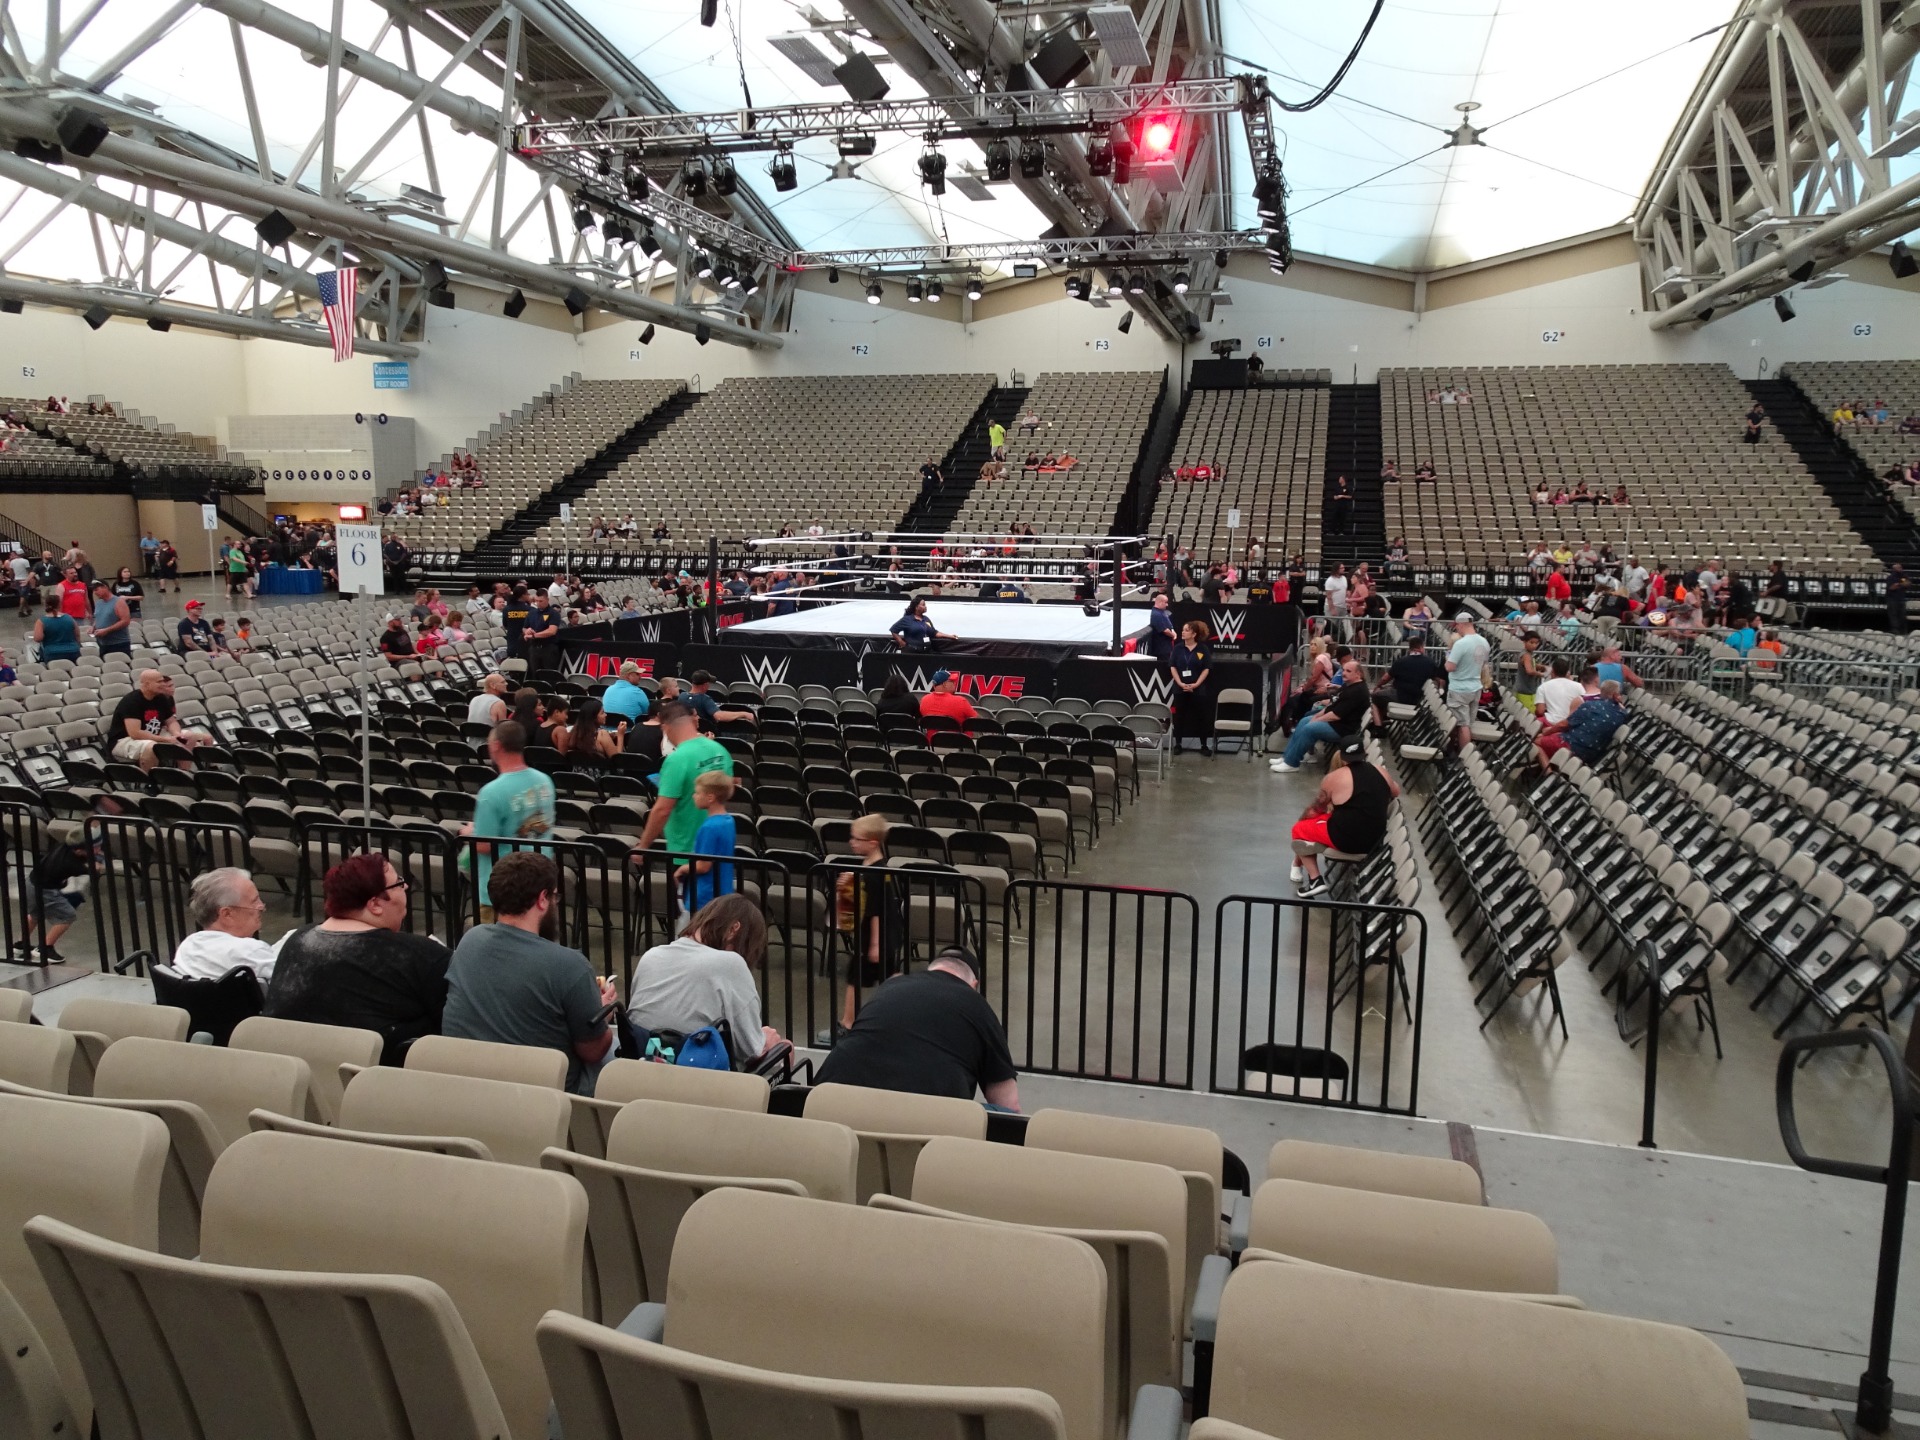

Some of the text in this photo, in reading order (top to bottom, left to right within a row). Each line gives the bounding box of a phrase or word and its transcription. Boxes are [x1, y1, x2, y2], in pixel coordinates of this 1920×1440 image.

[1853, 324, 1872, 336] G-3
[1257, 336, 1272, 347] G-1
[1542, 331, 1559, 342] G-2
[856, 345, 869, 355] F-2
[1096, 340, 1109, 350] F-3
[629, 350, 640, 360] F-1
[22, 366, 36, 378] E-2
[339, 528, 378, 539] FLOOR
[352, 542, 366, 566] 6
[507, 610, 529, 619] SECURIT
